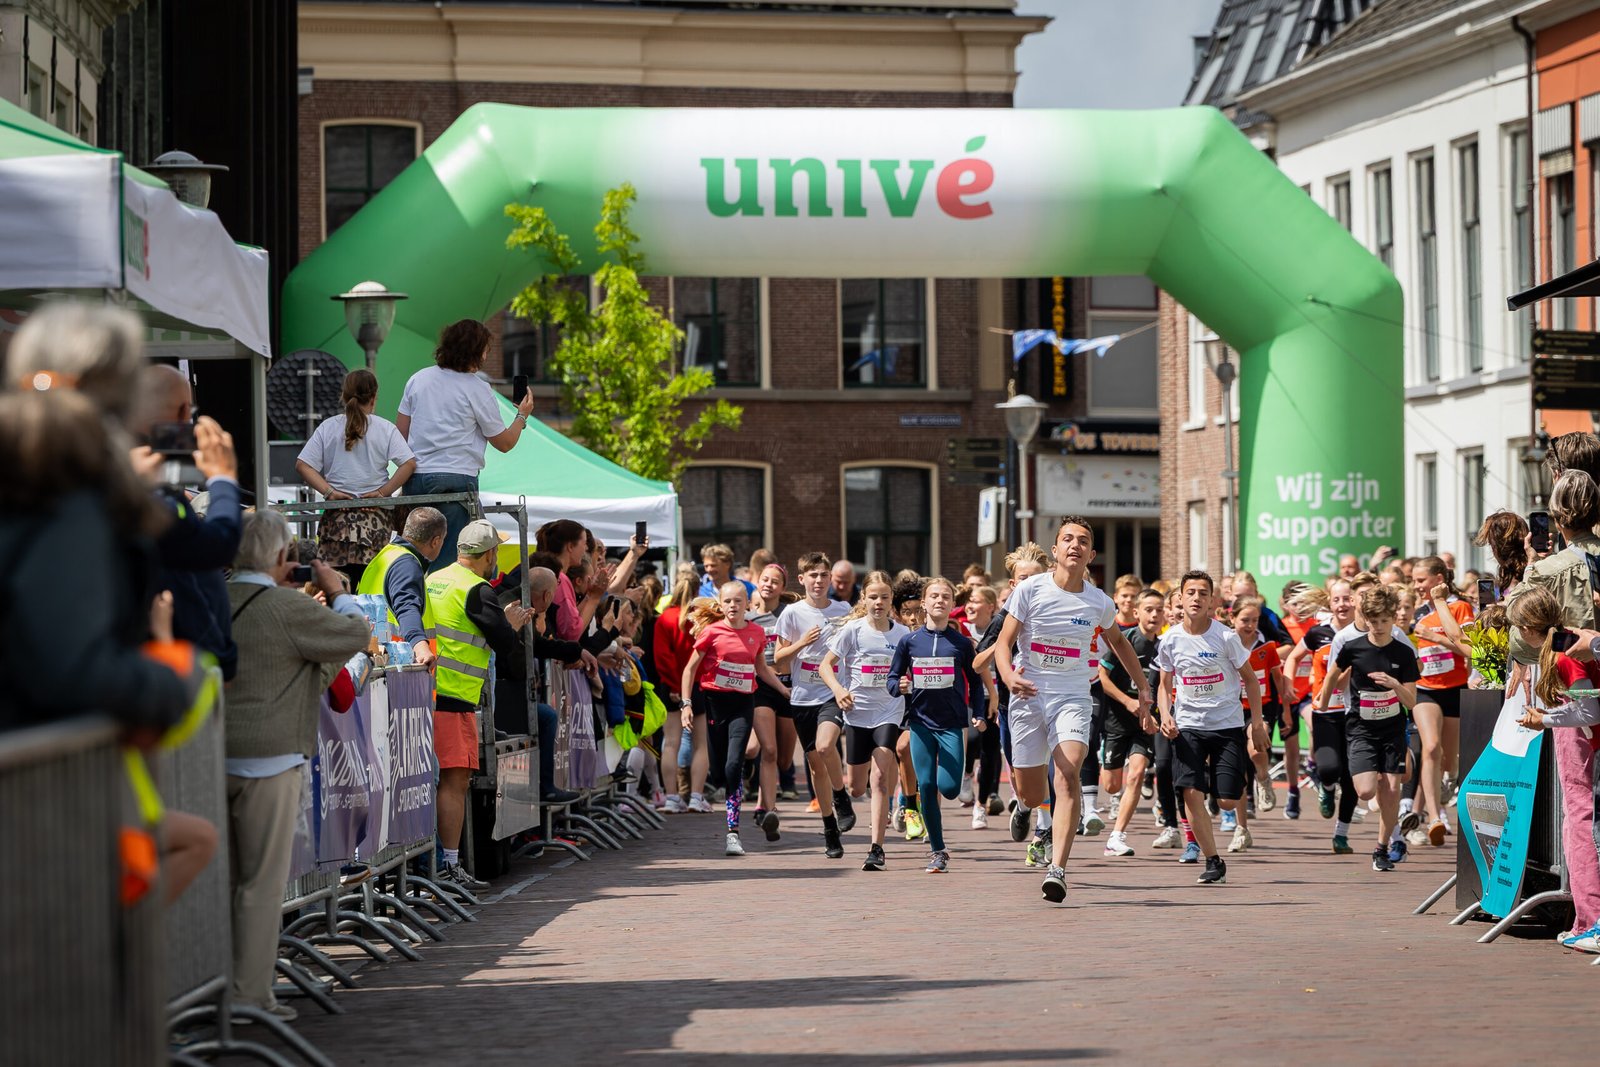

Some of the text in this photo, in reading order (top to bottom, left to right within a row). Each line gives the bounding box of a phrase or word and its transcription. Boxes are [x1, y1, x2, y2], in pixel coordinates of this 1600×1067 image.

[1074, 432, 1097, 450] DE
[1275, 472, 1380, 510] Wij zijn
[1257, 510, 1396, 546] Supporter
[1259, 553, 1311, 577] van
[1043, 646, 1067, 656] Yaman
[1043, 655, 1065, 665] 2159
[726, 678, 744, 686] 2070
[923, 675, 942, 683] 2013
[1185, 675, 1221, 685] Mohammed
[1194, 684, 1214, 692] 2160
[1372, 706, 1390, 714] 2202
